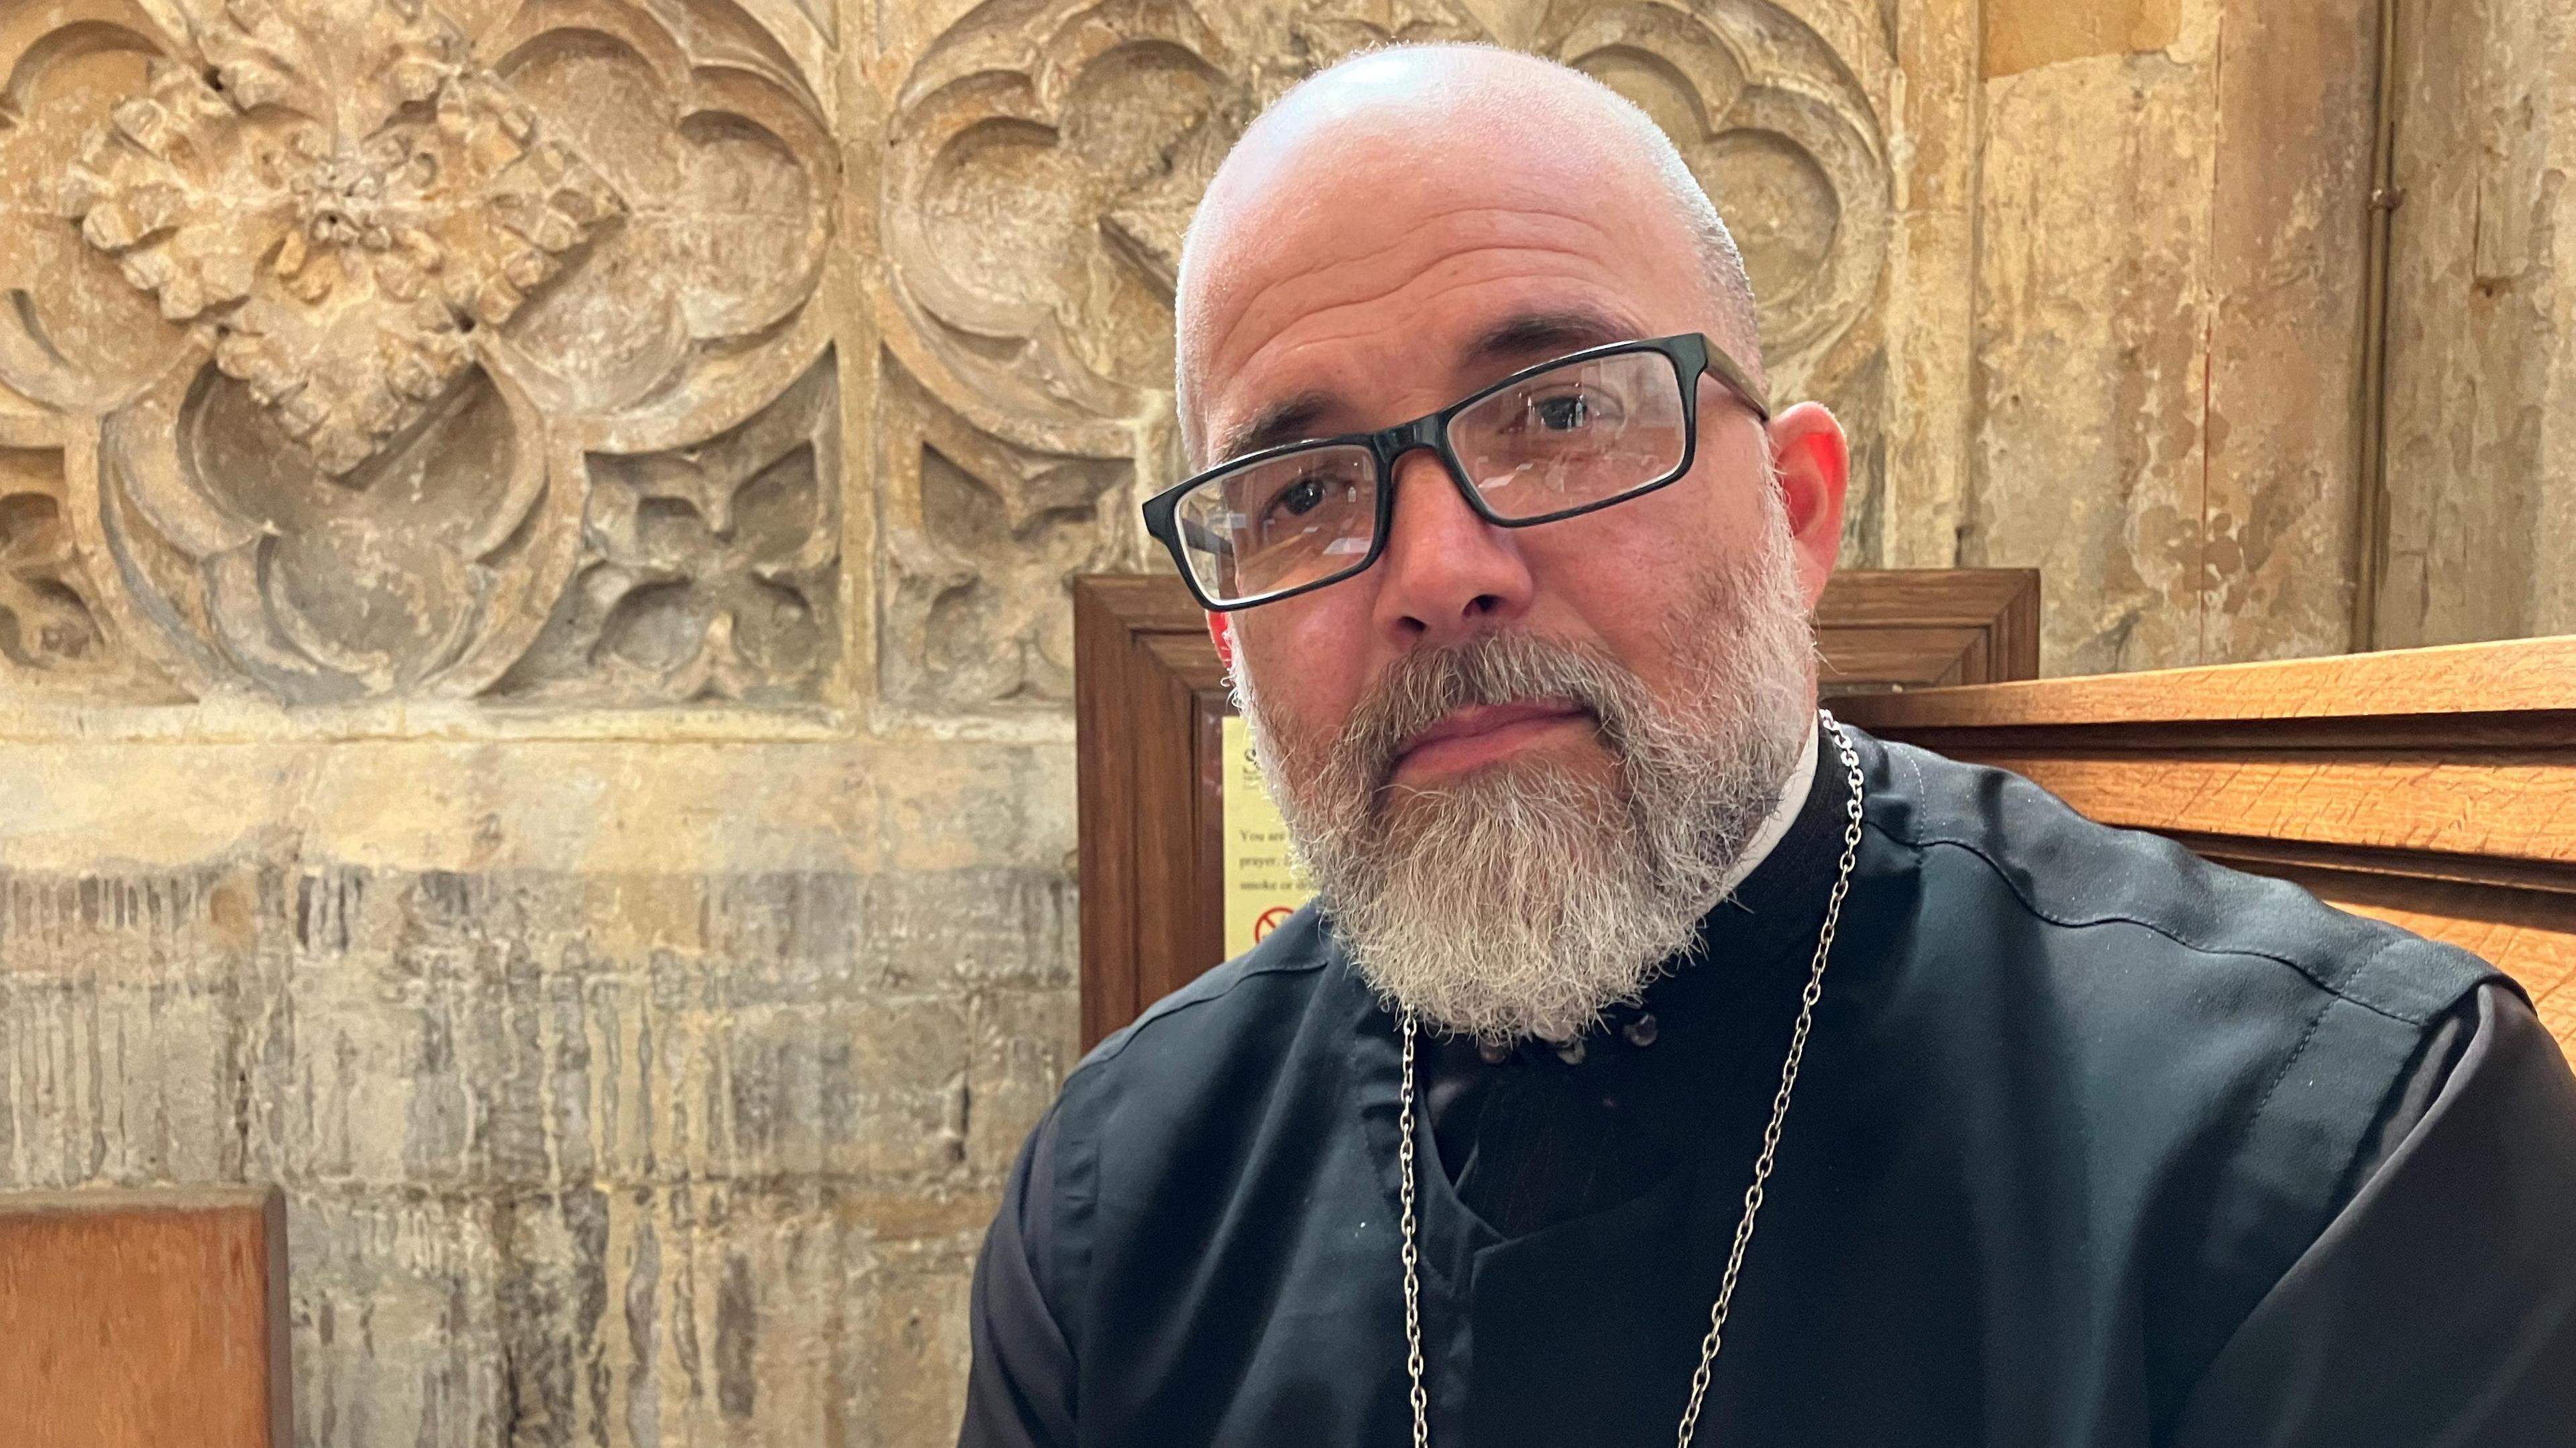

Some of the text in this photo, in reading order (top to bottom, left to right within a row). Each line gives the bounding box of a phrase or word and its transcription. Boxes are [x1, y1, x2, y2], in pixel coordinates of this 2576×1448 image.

[1240, 830, 1286, 842] You are
[1240, 879, 1276, 890] smoke
[1279, 882, 1292, 890] or
